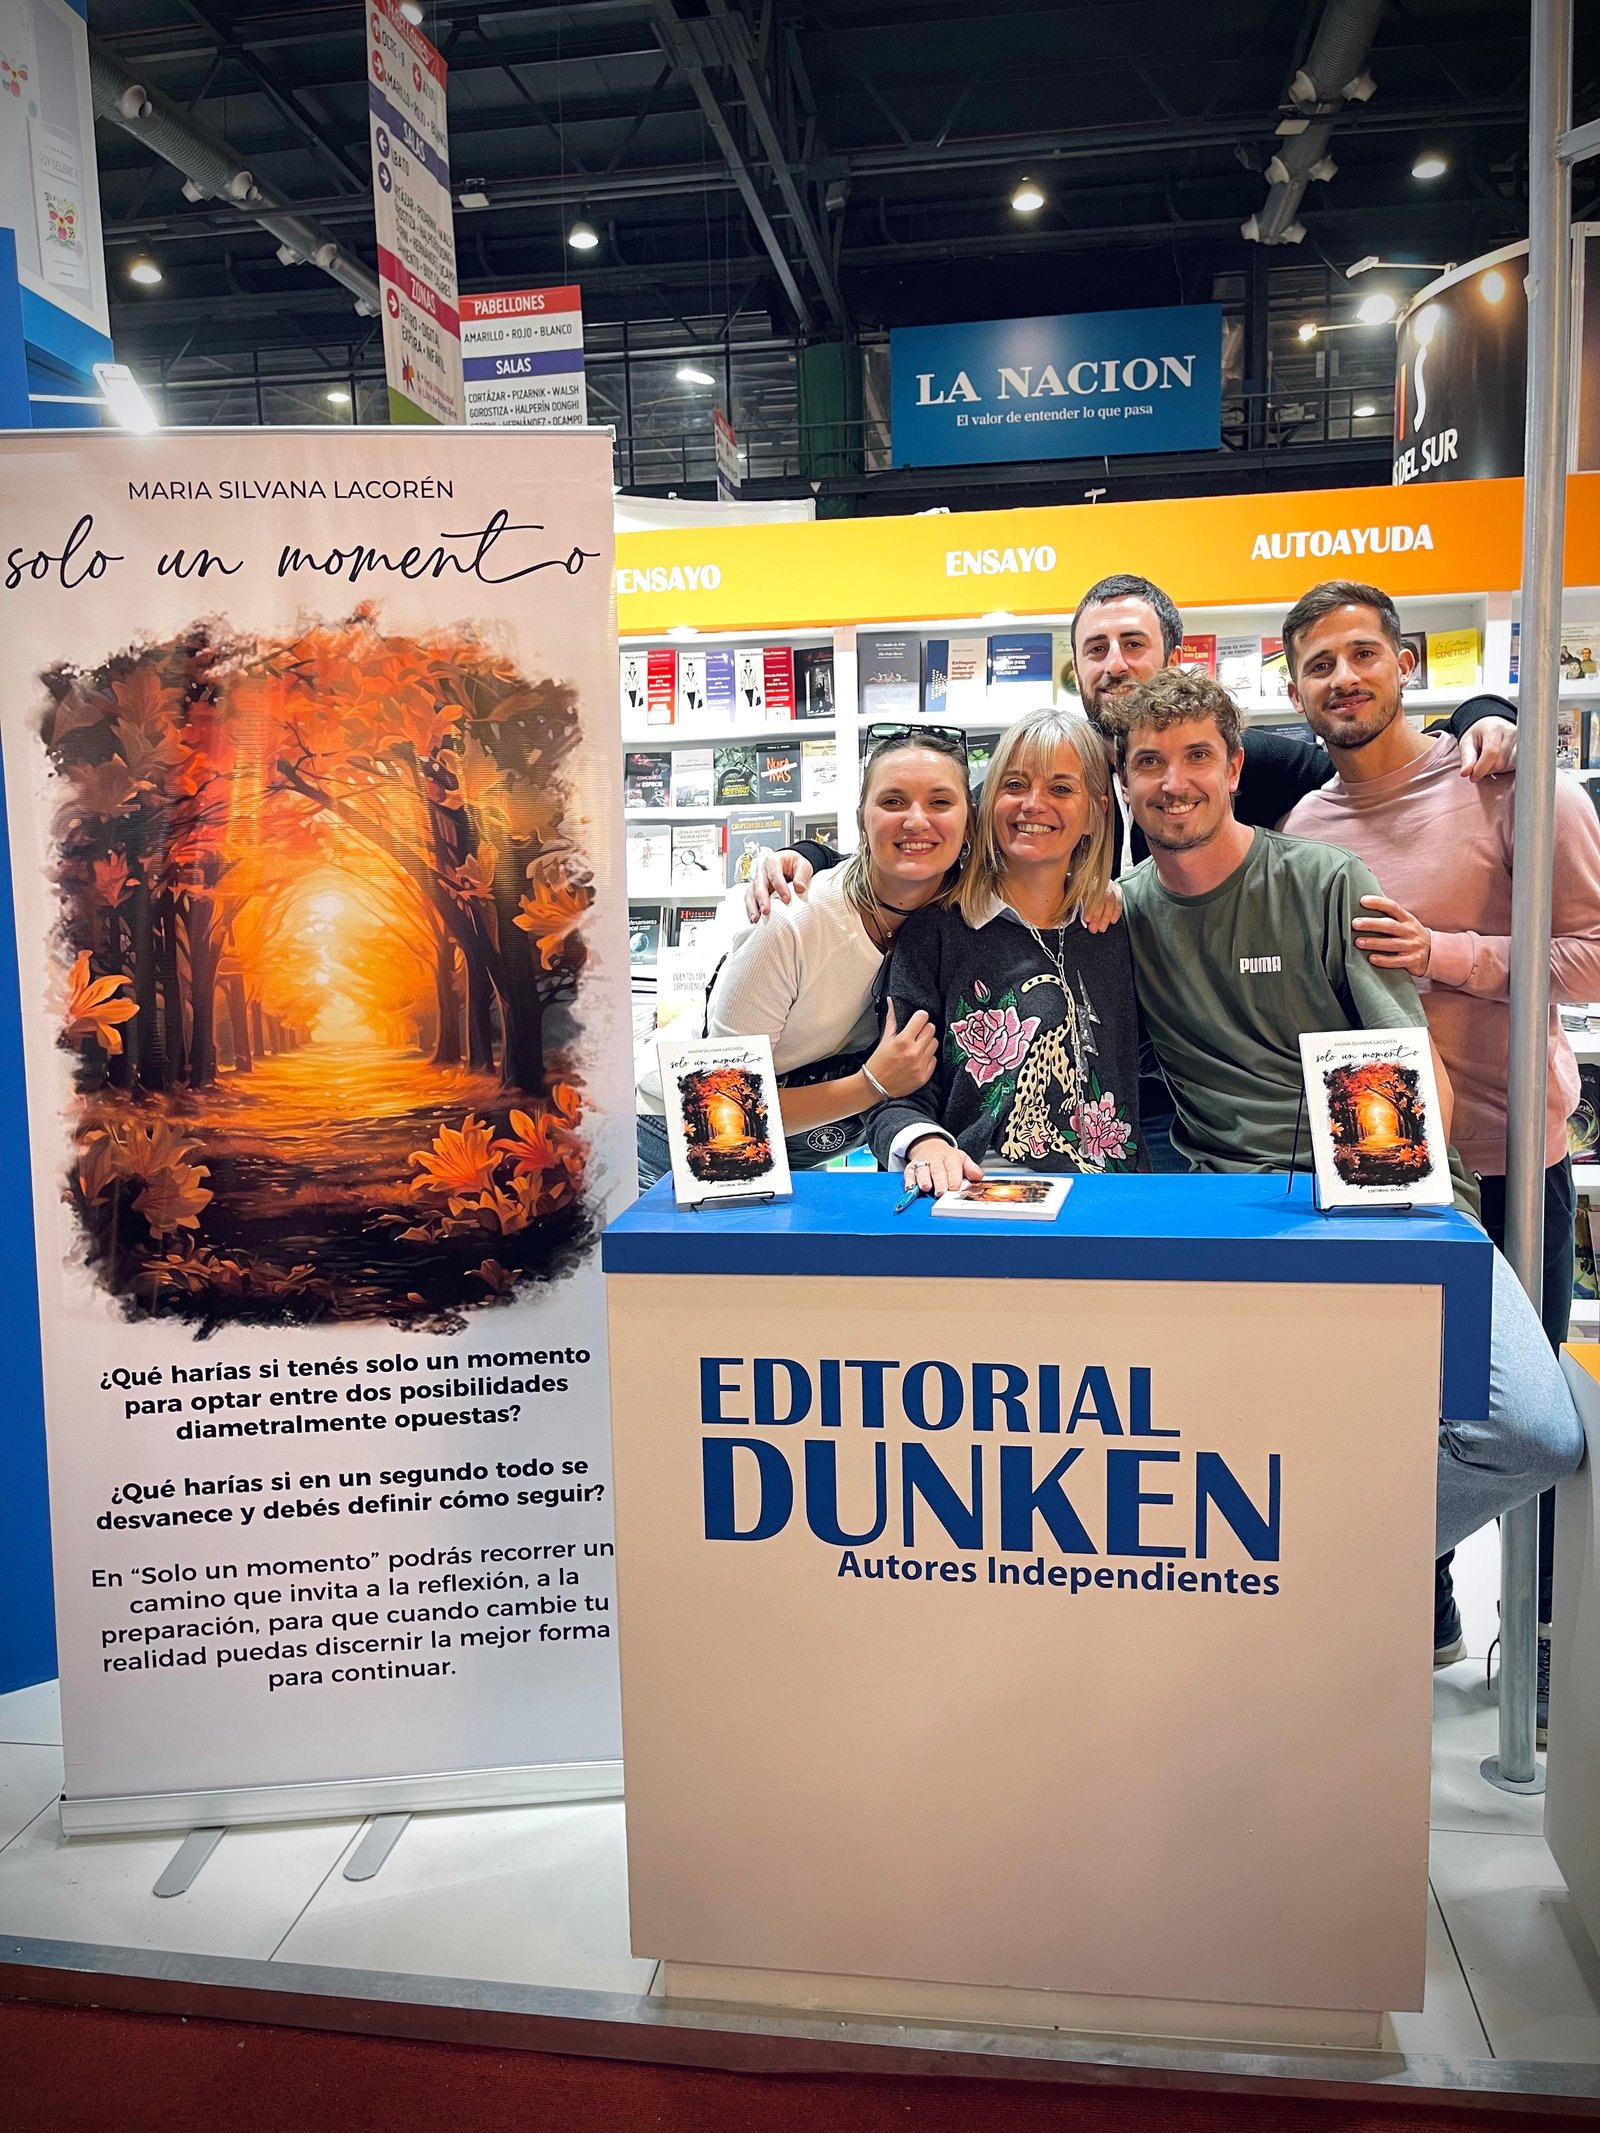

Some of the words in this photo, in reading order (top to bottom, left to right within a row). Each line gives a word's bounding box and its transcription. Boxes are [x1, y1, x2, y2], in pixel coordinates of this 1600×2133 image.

[403, 122, 426, 162] SALAS
[411, 277, 437, 315] ZONAS
[475, 295, 545, 316] PABELLONES
[463, 329, 504, 343] AMARILLO
[512, 328, 532, 340] ROJO
[540, 324, 573, 337] BLANCO
[495, 357, 532, 375] SALAS
[915, 371, 982, 406] LA
[997, 355, 1196, 400] NACION
[468, 389, 506, 404] CORTÁZAR
[512, 387, 546, 400] PIZARNIK
[552, 385, 579, 396] WALSH
[469, 405, 509, 418] GOROSTIZA
[515, 401, 551, 415] HALPERÍN
[552, 400, 580, 412] DONGHI
[553, 415, 582, 426] OCAMPO
[956, 413, 969, 427] El
[972, 412, 1003, 426] valor
[1005, 411, 1021, 423] de
[1024, 407, 1080, 422] entender
[1082, 405, 1094, 419] lo
[1097, 408, 1121, 421] que
[1123, 405, 1153, 418] pasa
[1398, 447, 1419, 486] DEL
[1421, 428, 1458, 472] SUR
[128, 481, 213, 500] MARIA
[219, 480, 327, 500] SILVANA
[334, 475, 453, 499] LACORÉN
[5, 514, 125, 590] solo
[157, 549, 244, 579] un
[277, 508, 601, 584] momento
[1250, 524, 1434, 560] AUTOAYUDA
[616, 564, 722, 594] ENSAYO
[945, 546, 1056, 577] ENSAYO
[1240, 956, 1281, 974] PUMA
[670, 1056, 690, 1069] solo
[712, 1052, 763, 1064] momento
[1316, 1049, 1337, 1062] solo
[1362, 1045, 1419, 1059] momento
[100, 1365, 163, 1390] ¿Qué
[171, 1361, 252, 1384] harías
[259, 1358, 279, 1379] si
[286, 1355, 359, 1378] tenés
[366, 1353, 419, 1374] solo
[426, 1355, 459, 1371] un
[467, 1347, 591, 1369] momento
[125, 1398, 183, 1420] para
[190, 1391, 262, 1415] optar
[269, 1387, 339, 1407] entre
[345, 1383, 392, 1403] dos
[400, 1374, 569, 1405] posibilidades
[700, 1358, 1180, 1437] EDITORIAL
[176, 1413, 387, 1441] diametralmente
[394, 1404, 522, 1432] opuestas?
[111, 1482, 176, 1505] ¿Qué
[184, 1474, 263, 1497] harías
[271, 1471, 291, 1491] si
[299, 1474, 331, 1490] en
[338, 1472, 371, 1488] un
[379, 1461, 489, 1488] segundo
[495, 1457, 555, 1479] todo
[561, 1460, 589, 1475] se
[702, 1437, 1280, 1561] DUNKEN
[96, 1508, 233, 1530] desvanece
[239, 1506, 256, 1526] y
[263, 1497, 341, 1520] debés
[348, 1491, 432, 1515] definir
[439, 1489, 510, 1510] cómo
[516, 1482, 605, 1508] seguir?
[91, 1569, 123, 1588] En
[130, 1563, 197, 1585] “Solo
[205, 1564, 238, 1580] un
[247, 1551, 380, 1577] momento”
[388, 1546, 473, 1573] podrás
[480, 1543, 577, 1563] recorrer
[583, 1540, 614, 1557] un
[838, 1551, 976, 1582] Autores
[989, 1557, 1279, 1595] Independientes
[129, 1590, 226, 1614] camino
[233, 1589, 282, 1610] que
[290, 1581, 358, 1603] invita
[366, 1583, 380, 1597] a
[389, 1577, 409, 1596] la
[418, 1570, 530, 1594] reflexión,
[536, 1573, 550, 1587] a
[559, 1567, 579, 1586] la
[101, 1615, 260, 1647] preparación,
[269, 1615, 323, 1636] para
[331, 1611, 379, 1631] que
[386, 1601, 479, 1624] cuando
[486, 1594, 577, 1618] cambie
[584, 1595, 609, 1612] tu
[103, 1647, 207, 1673] realidad
[216, 1640, 308, 1668] puedas
[315, 1635, 423, 1656] discernir
[431, 1630, 451, 1649] la
[460, 1625, 532, 1649] mejor
[538, 1623, 610, 1642] forma
[268, 1670, 323, 1692] para
[331, 1660, 456, 1683] continuar.
